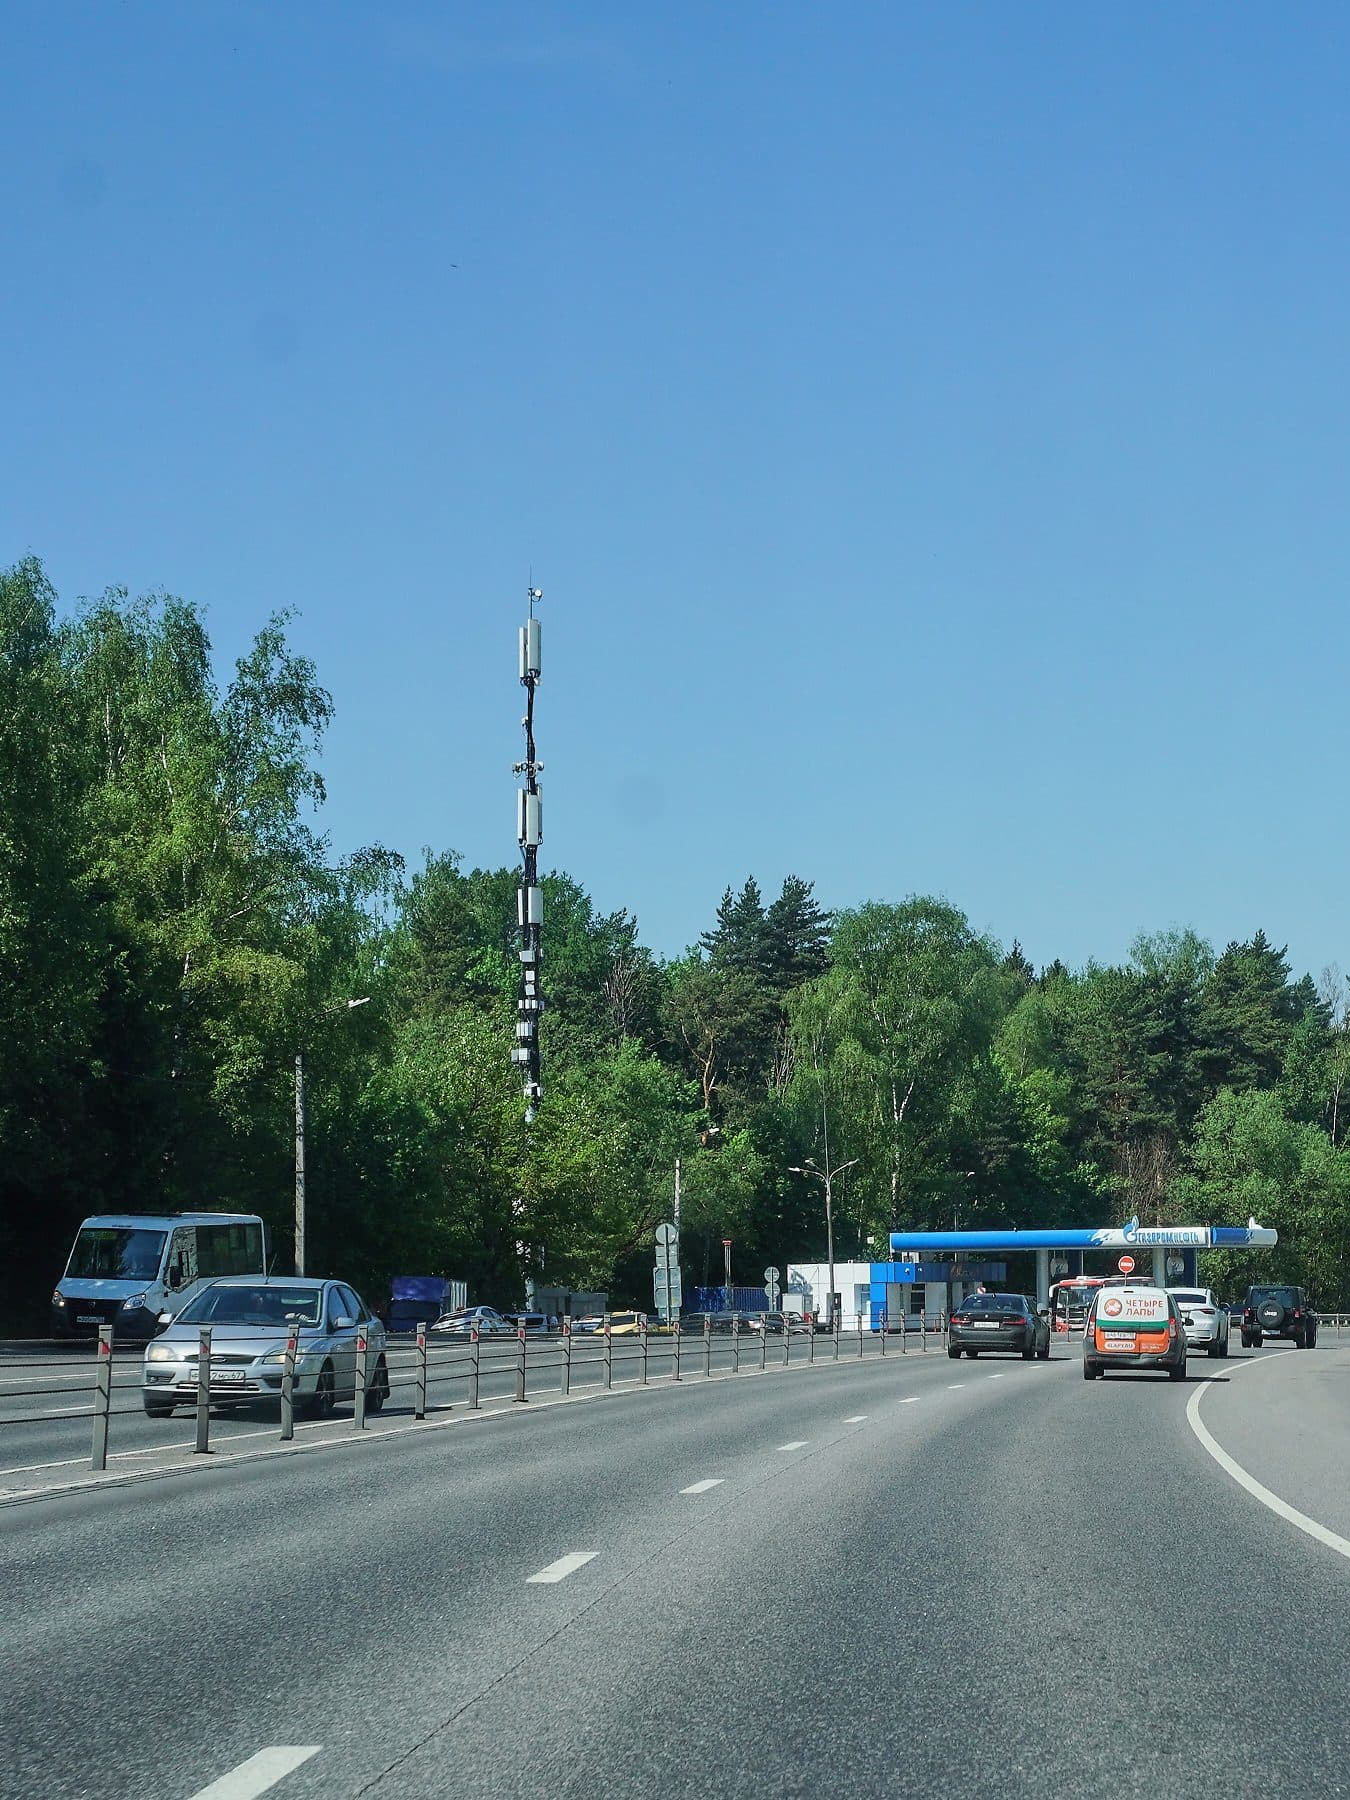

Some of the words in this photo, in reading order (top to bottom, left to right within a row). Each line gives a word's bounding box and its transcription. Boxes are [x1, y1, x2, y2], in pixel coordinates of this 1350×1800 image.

[1136, 1230, 1200, 1243] ГАЗПРОМНЕФТЬ
[1126, 1299, 1164, 1308] ЧЕТЫРЕ
[1126, 1308, 1155, 1316] ЛАПЫ
